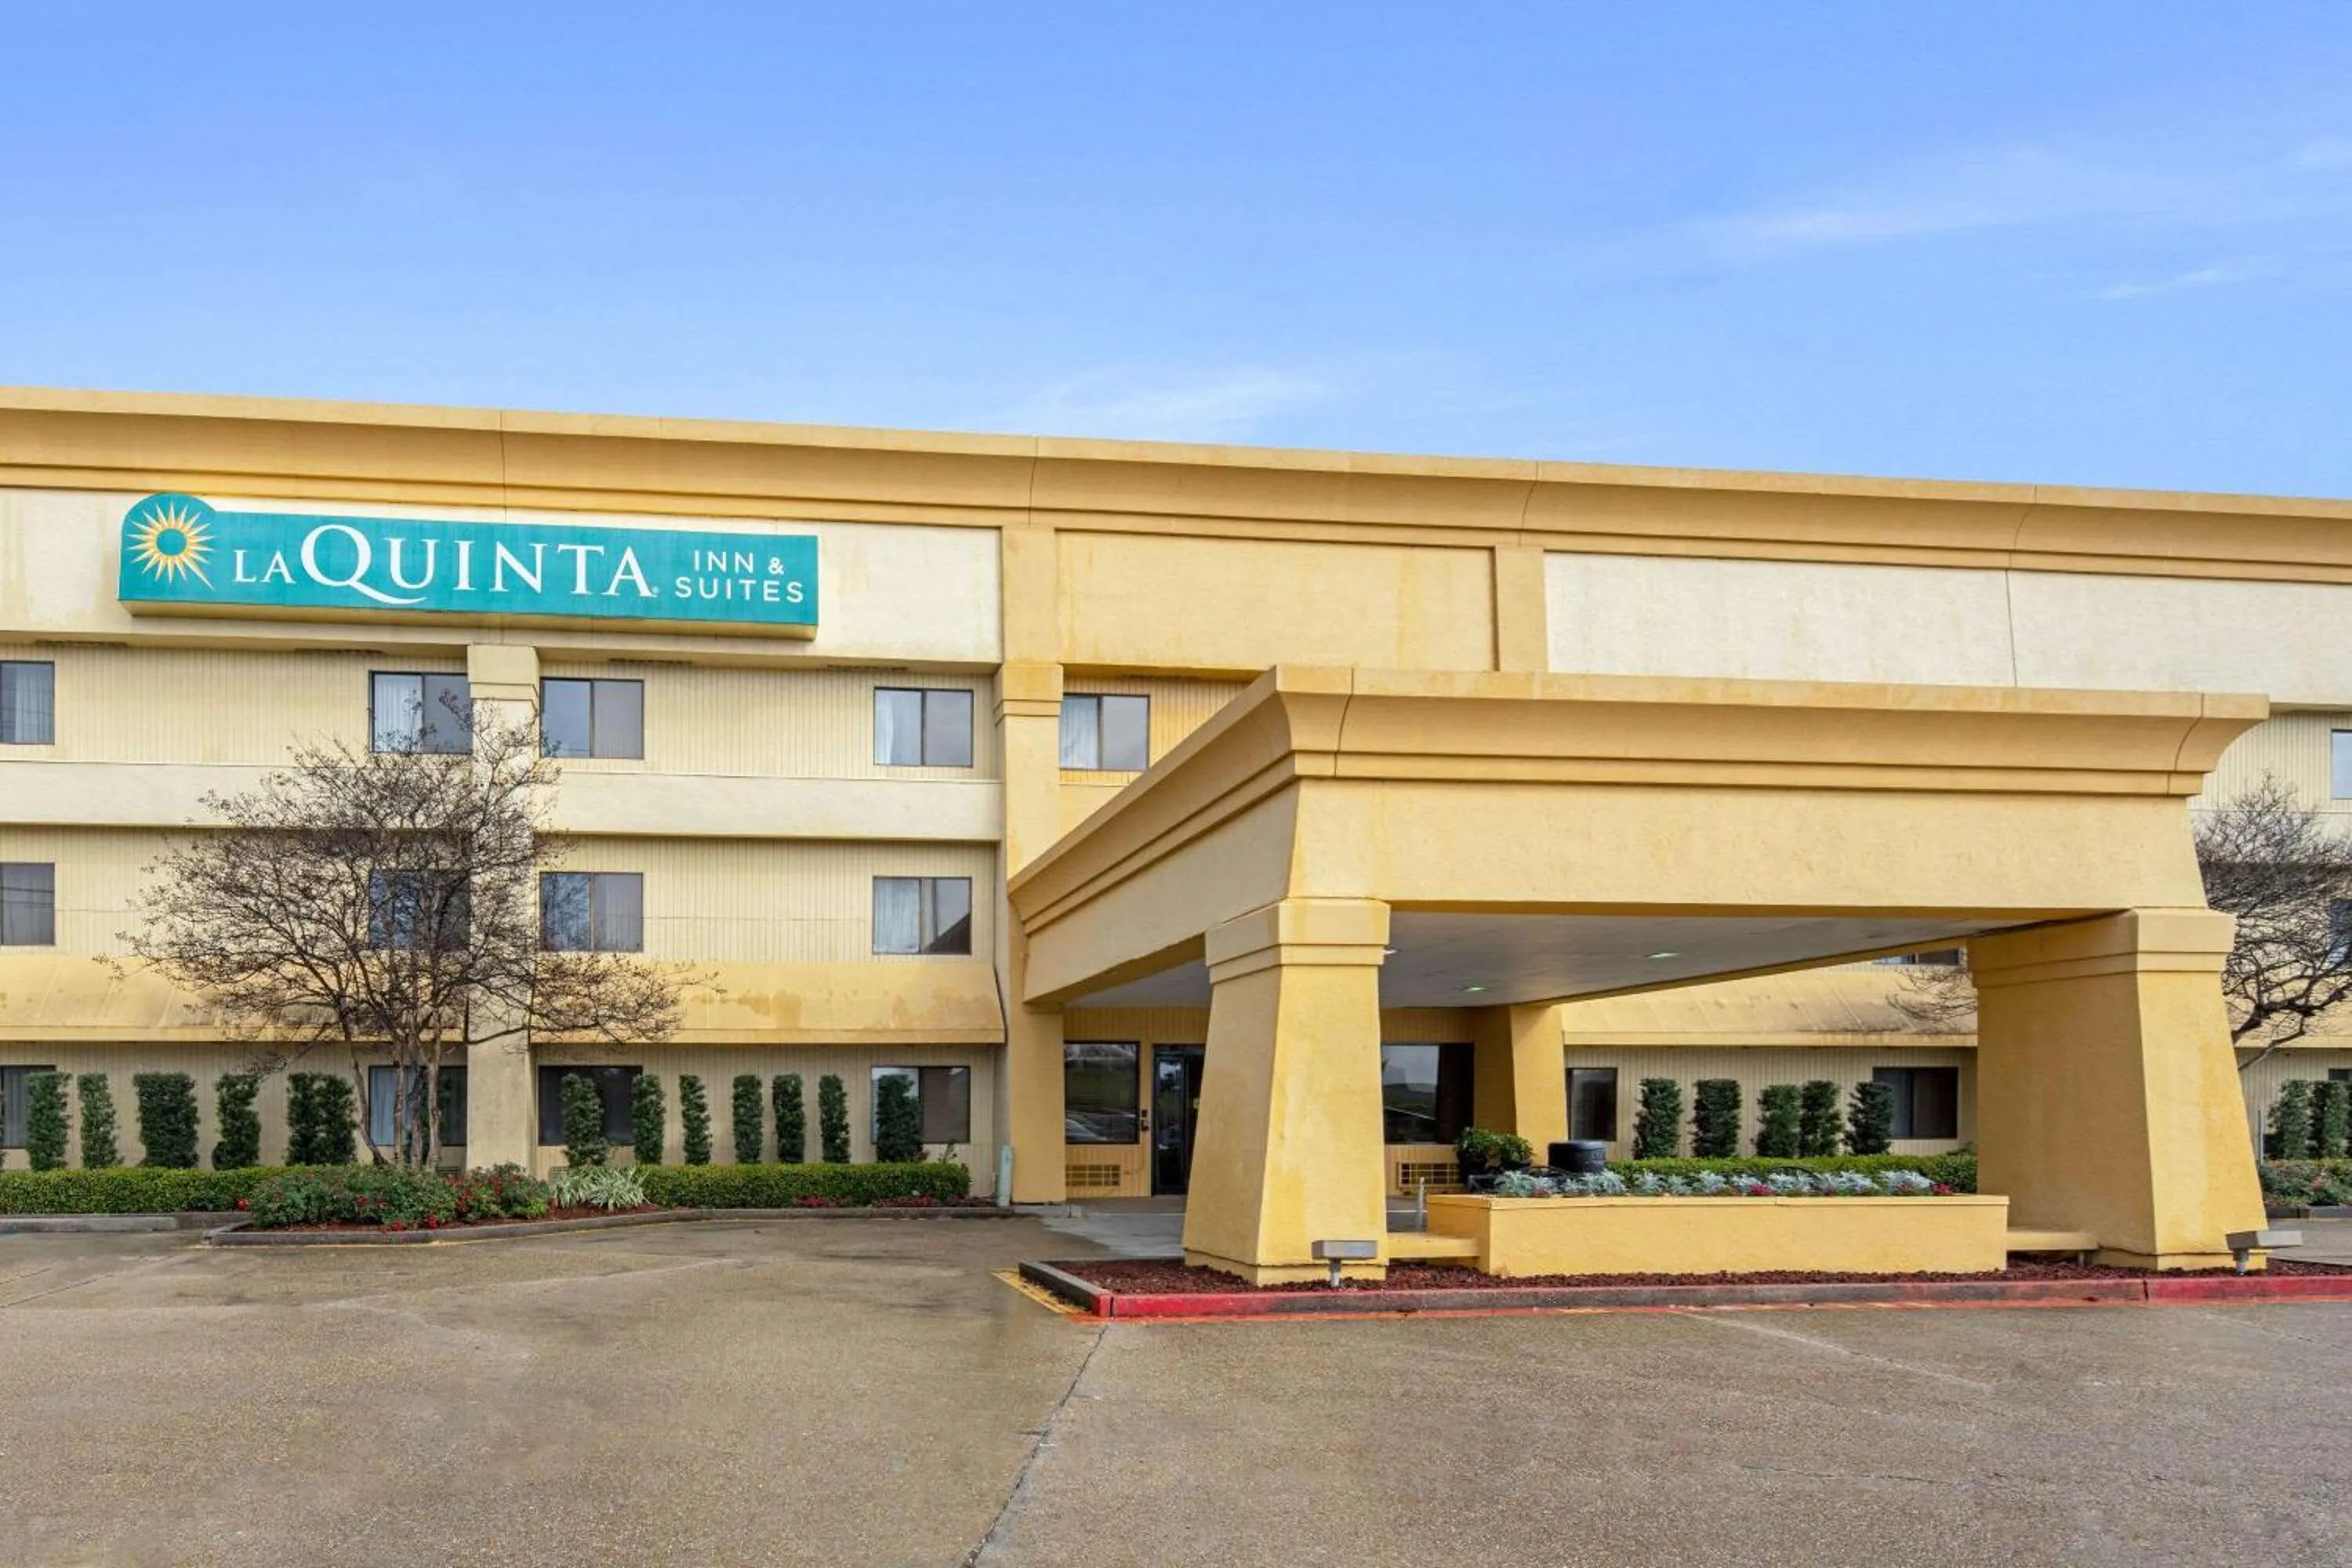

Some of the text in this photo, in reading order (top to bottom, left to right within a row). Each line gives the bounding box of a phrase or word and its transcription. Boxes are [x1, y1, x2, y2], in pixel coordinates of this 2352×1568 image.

[233, 523, 652, 605] LA QUINTA
[693, 549, 785, 575] INN &
[674, 575, 804, 603] SUITES
